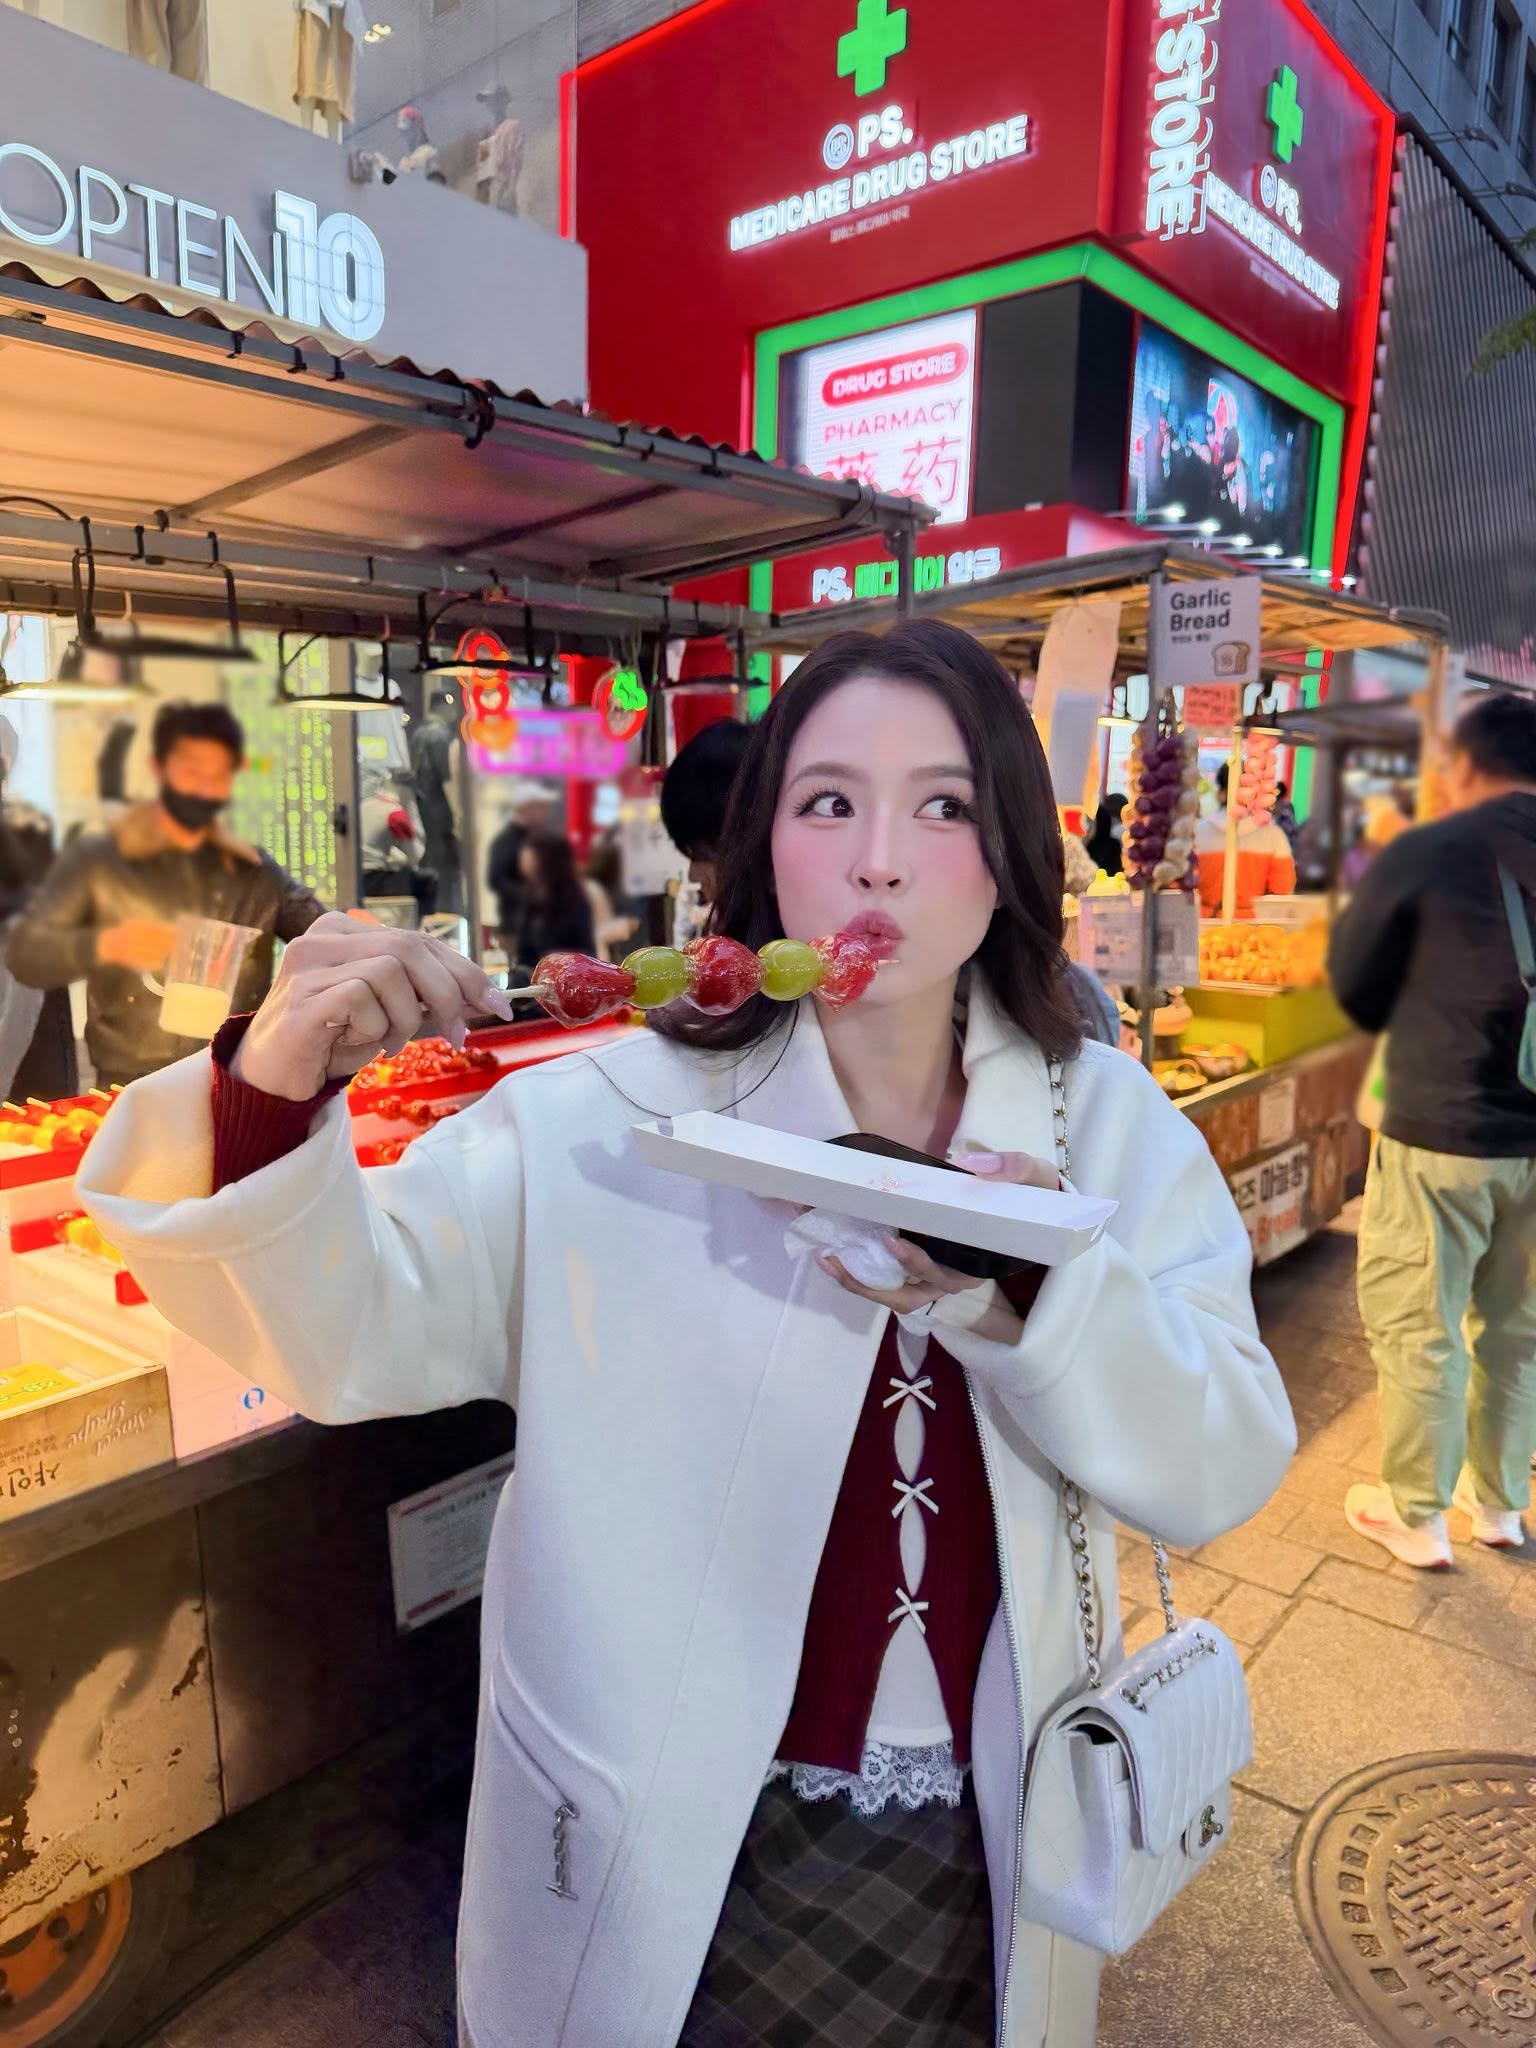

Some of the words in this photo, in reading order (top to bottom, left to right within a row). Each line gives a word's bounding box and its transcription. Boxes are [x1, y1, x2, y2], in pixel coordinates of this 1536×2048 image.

[857, 104, 914, 158] PS.
[1145, 24, 1210, 235] STORE
[729, 178, 851, 251] MEDICARE
[852, 151, 928, 209] DRUG
[929, 114, 1028, 182] STORE
[832, 367, 887, 399] DRUG
[889, 351, 957, 385] STORE
[823, 397, 963, 443] PHARMACY
[1170, 588, 1232, 611] Garlic
[1170, 610, 1231, 633] Bread
[0, 1460, 62, 1498] 샤인
